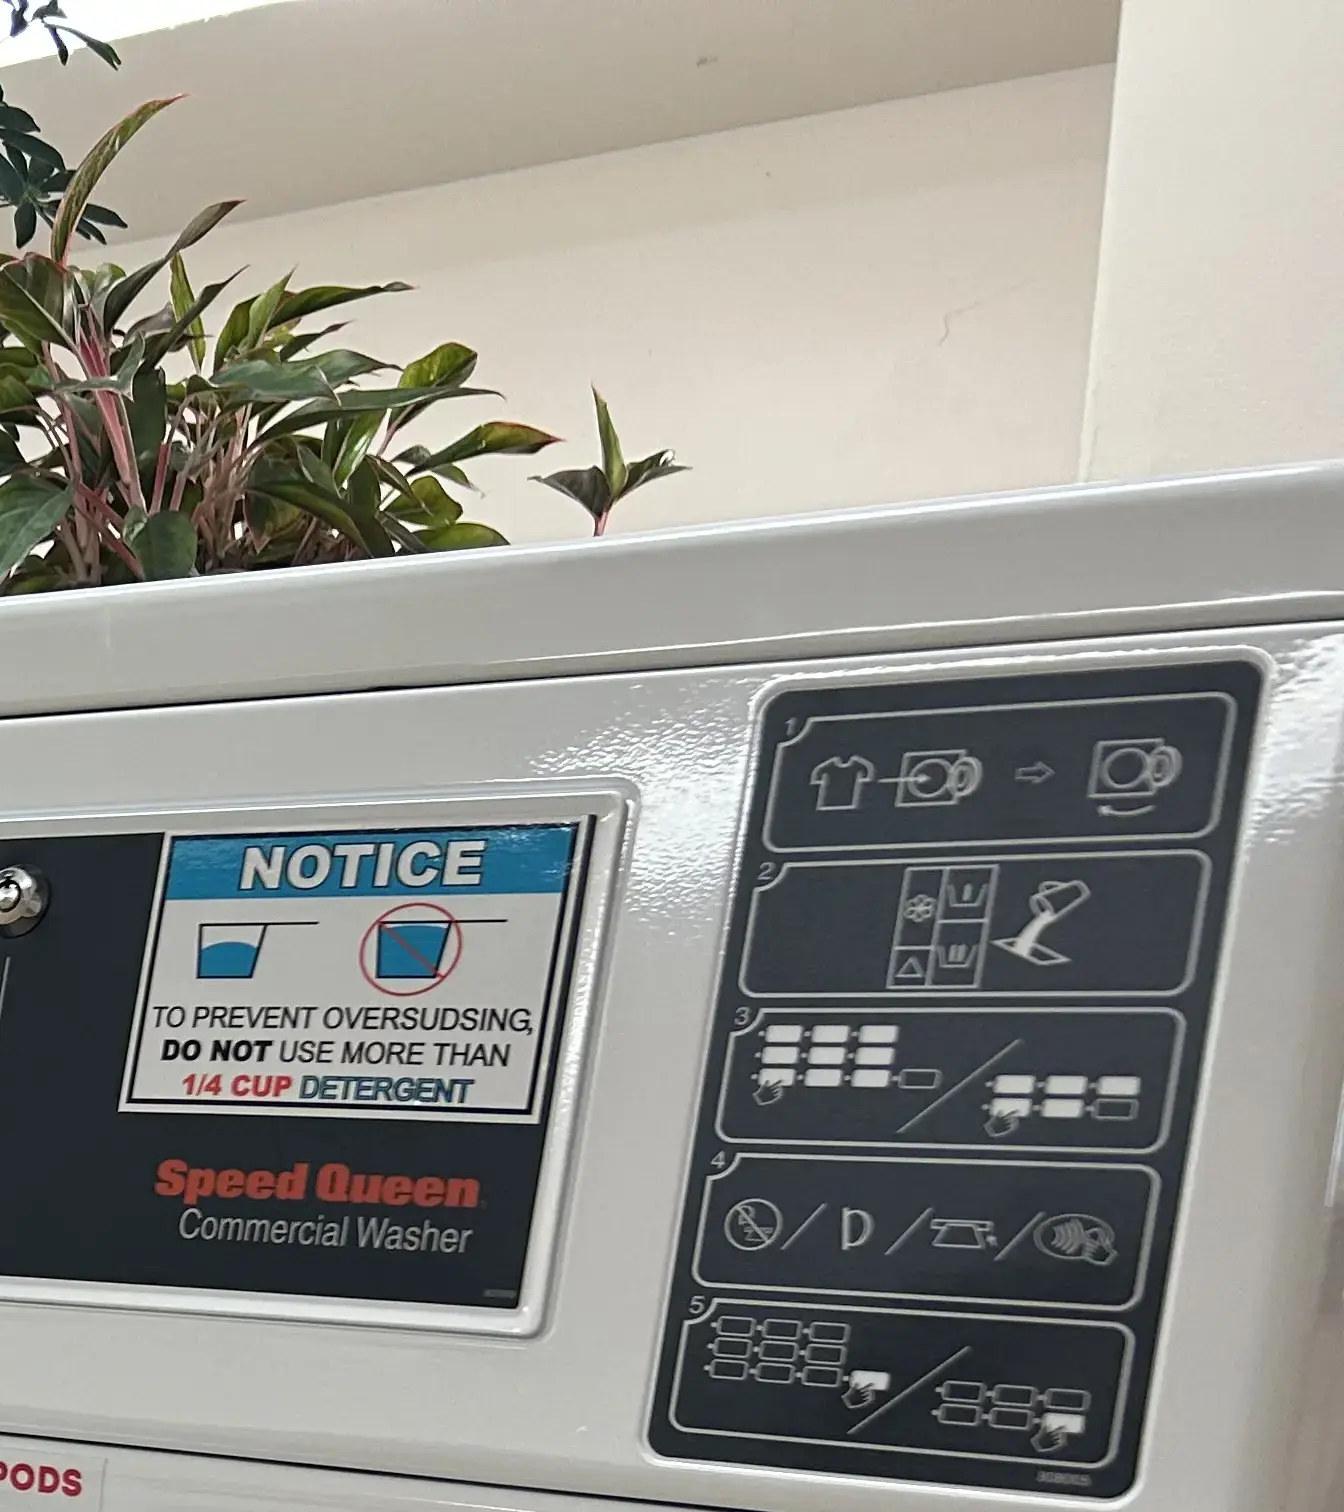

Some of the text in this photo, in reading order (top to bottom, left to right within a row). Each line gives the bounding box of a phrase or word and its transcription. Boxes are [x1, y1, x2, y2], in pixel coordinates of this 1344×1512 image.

[784, 718, 796, 737] 1
[238, 838, 487, 891] NOTICE
[757, 863, 775, 882] 2
[153, 1006, 533, 1036] TO PREVENT OVERSUDSING,
[733, 1007, 751, 1027] 3
[161, 1039, 511, 1067] DO NOT USE MORE THAN
[182, 1074, 476, 1104] 1/4 CUP DETERGENT
[710, 1150, 727, 1170] 4
[154, 1159, 482, 1208] Speed Queen
[178, 1208, 473, 1254] Commercial Washer
[688, 1295, 707, 1315] 5
